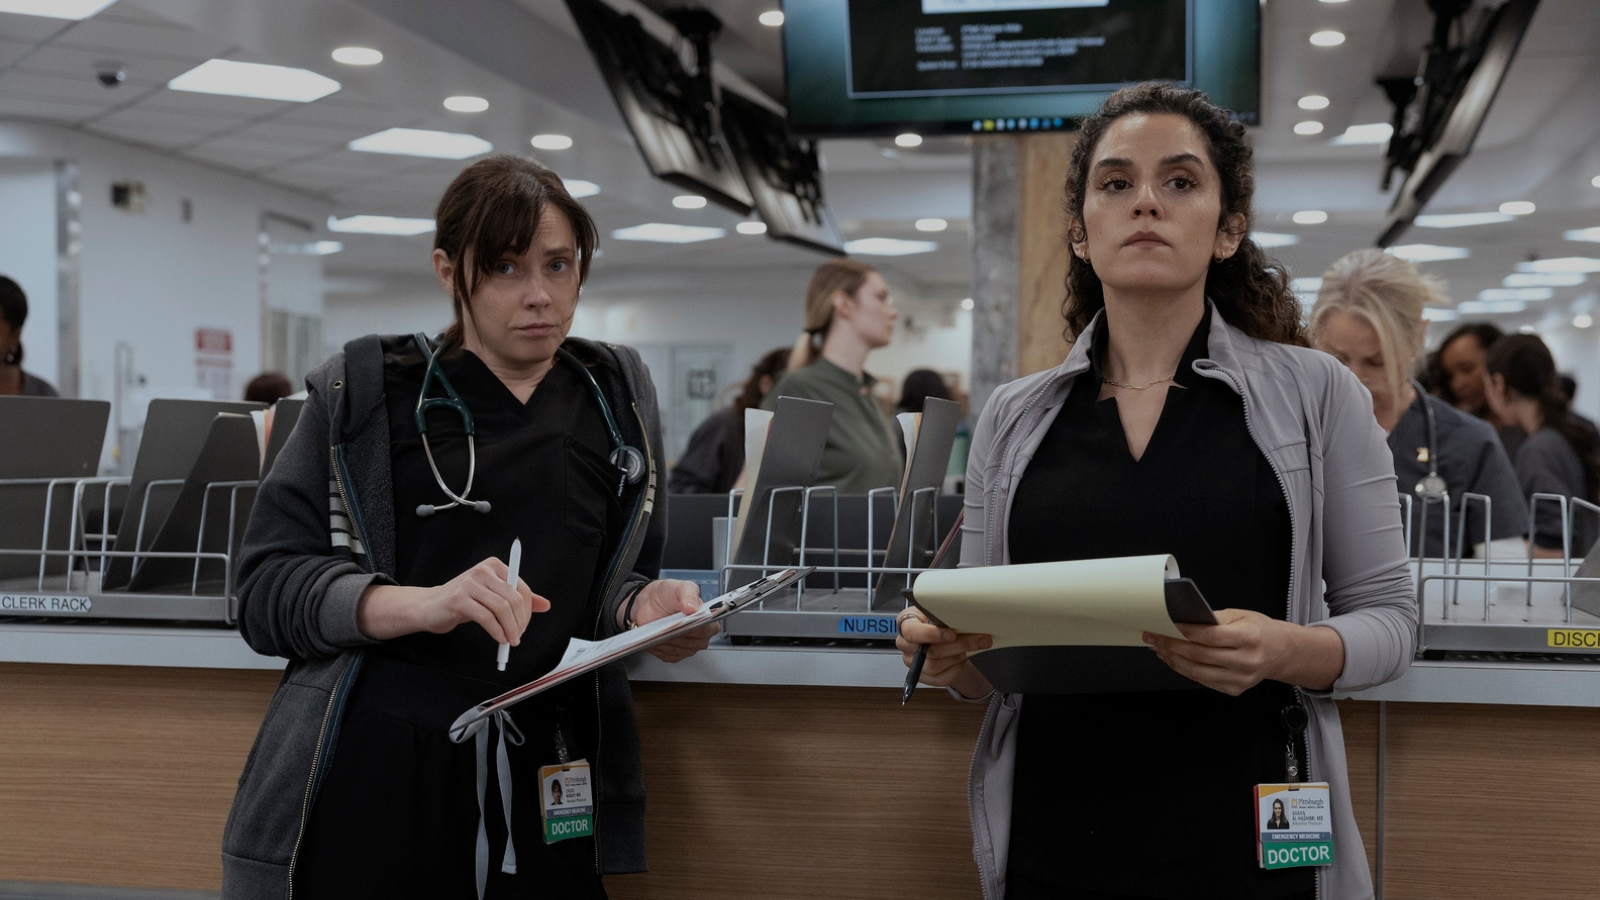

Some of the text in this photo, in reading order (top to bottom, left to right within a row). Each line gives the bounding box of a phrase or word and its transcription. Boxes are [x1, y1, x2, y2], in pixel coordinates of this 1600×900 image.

[2, 596, 88, 611] CLERK RACK
[844, 618, 897, 633] NURSI
[1554, 632, 1600, 647] DISC
[1298, 797, 1324, 805] Pittsburgh
[552, 819, 588, 835] DOCTOR
[1268, 845, 1330, 864] DOCTOR
